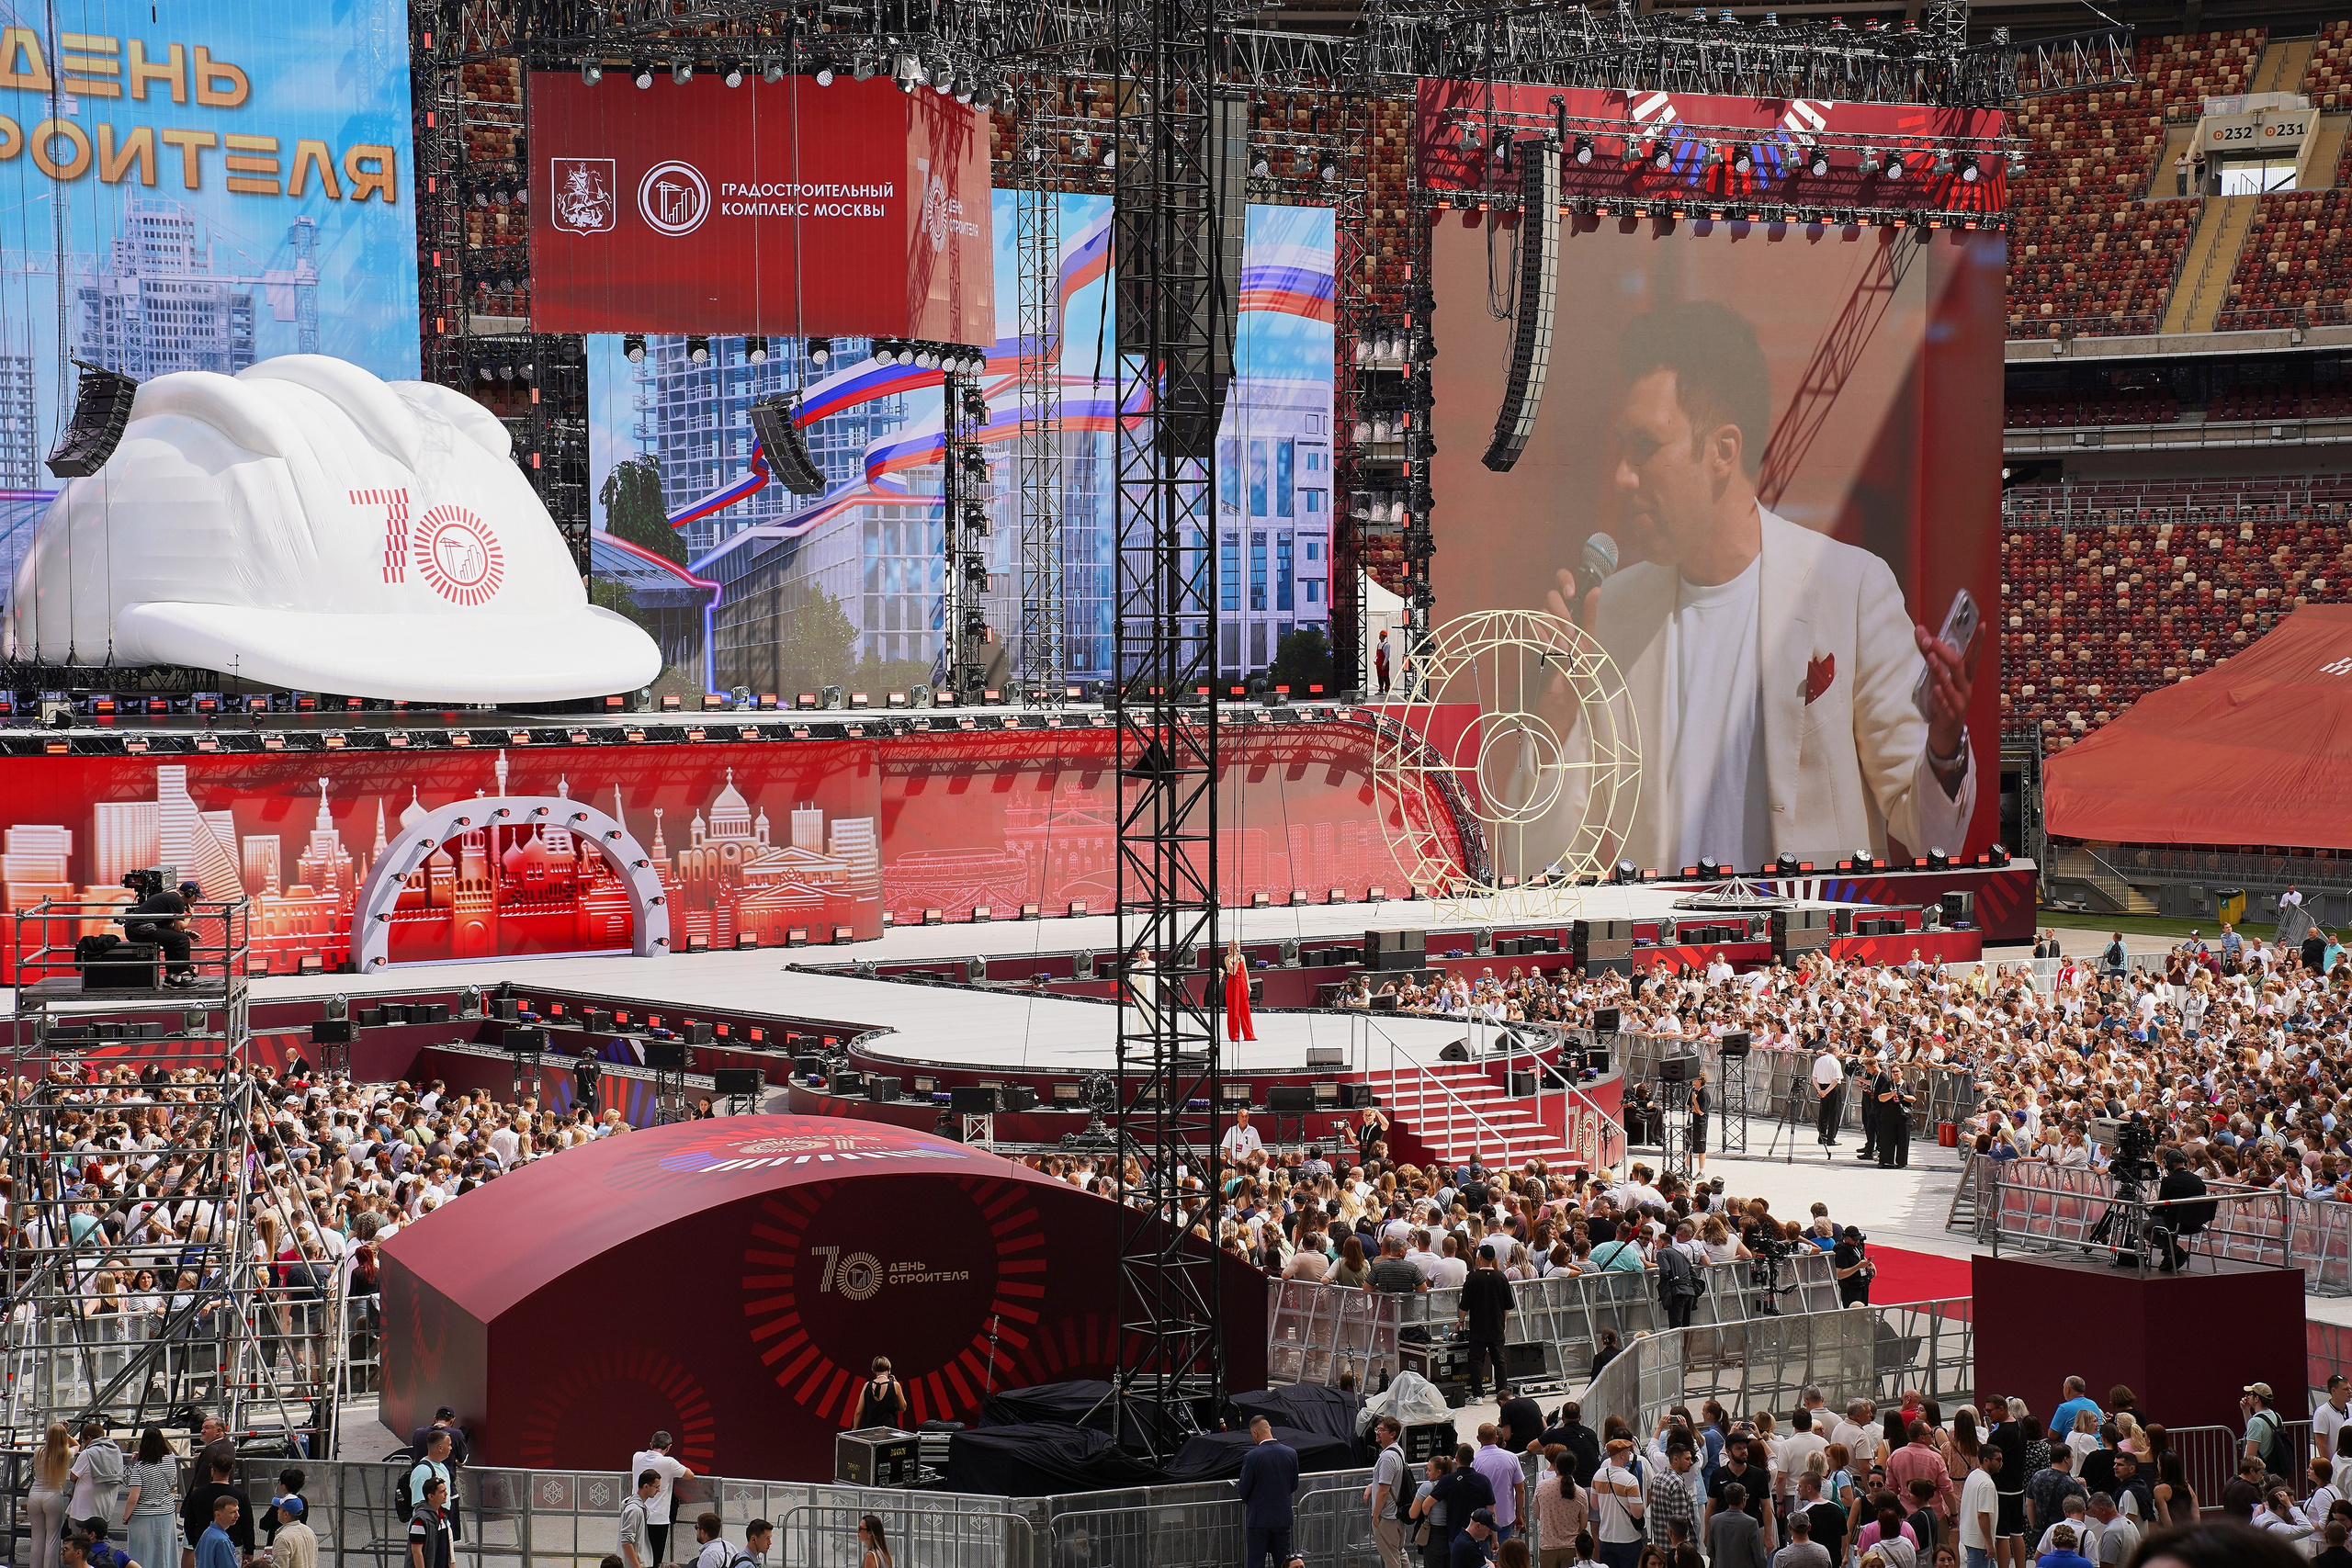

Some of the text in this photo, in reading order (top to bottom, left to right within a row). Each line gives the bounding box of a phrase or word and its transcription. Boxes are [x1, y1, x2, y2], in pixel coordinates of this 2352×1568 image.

[0, 27, 250, 107] ДЕНЬ
[2224, 127, 2253, 140] 232
[2277, 123, 2304, 136] 231
[721, 182, 893, 197] ГРАДОСТРОИТЕЛЬНЫЙ
[721, 203, 885, 217] КОМПЛЕКС МОСКВЫ
[889, 1261, 926, 1272] ДЕНЬ
[889, 1270, 969, 1284] СТРОИТЕЛЯ
